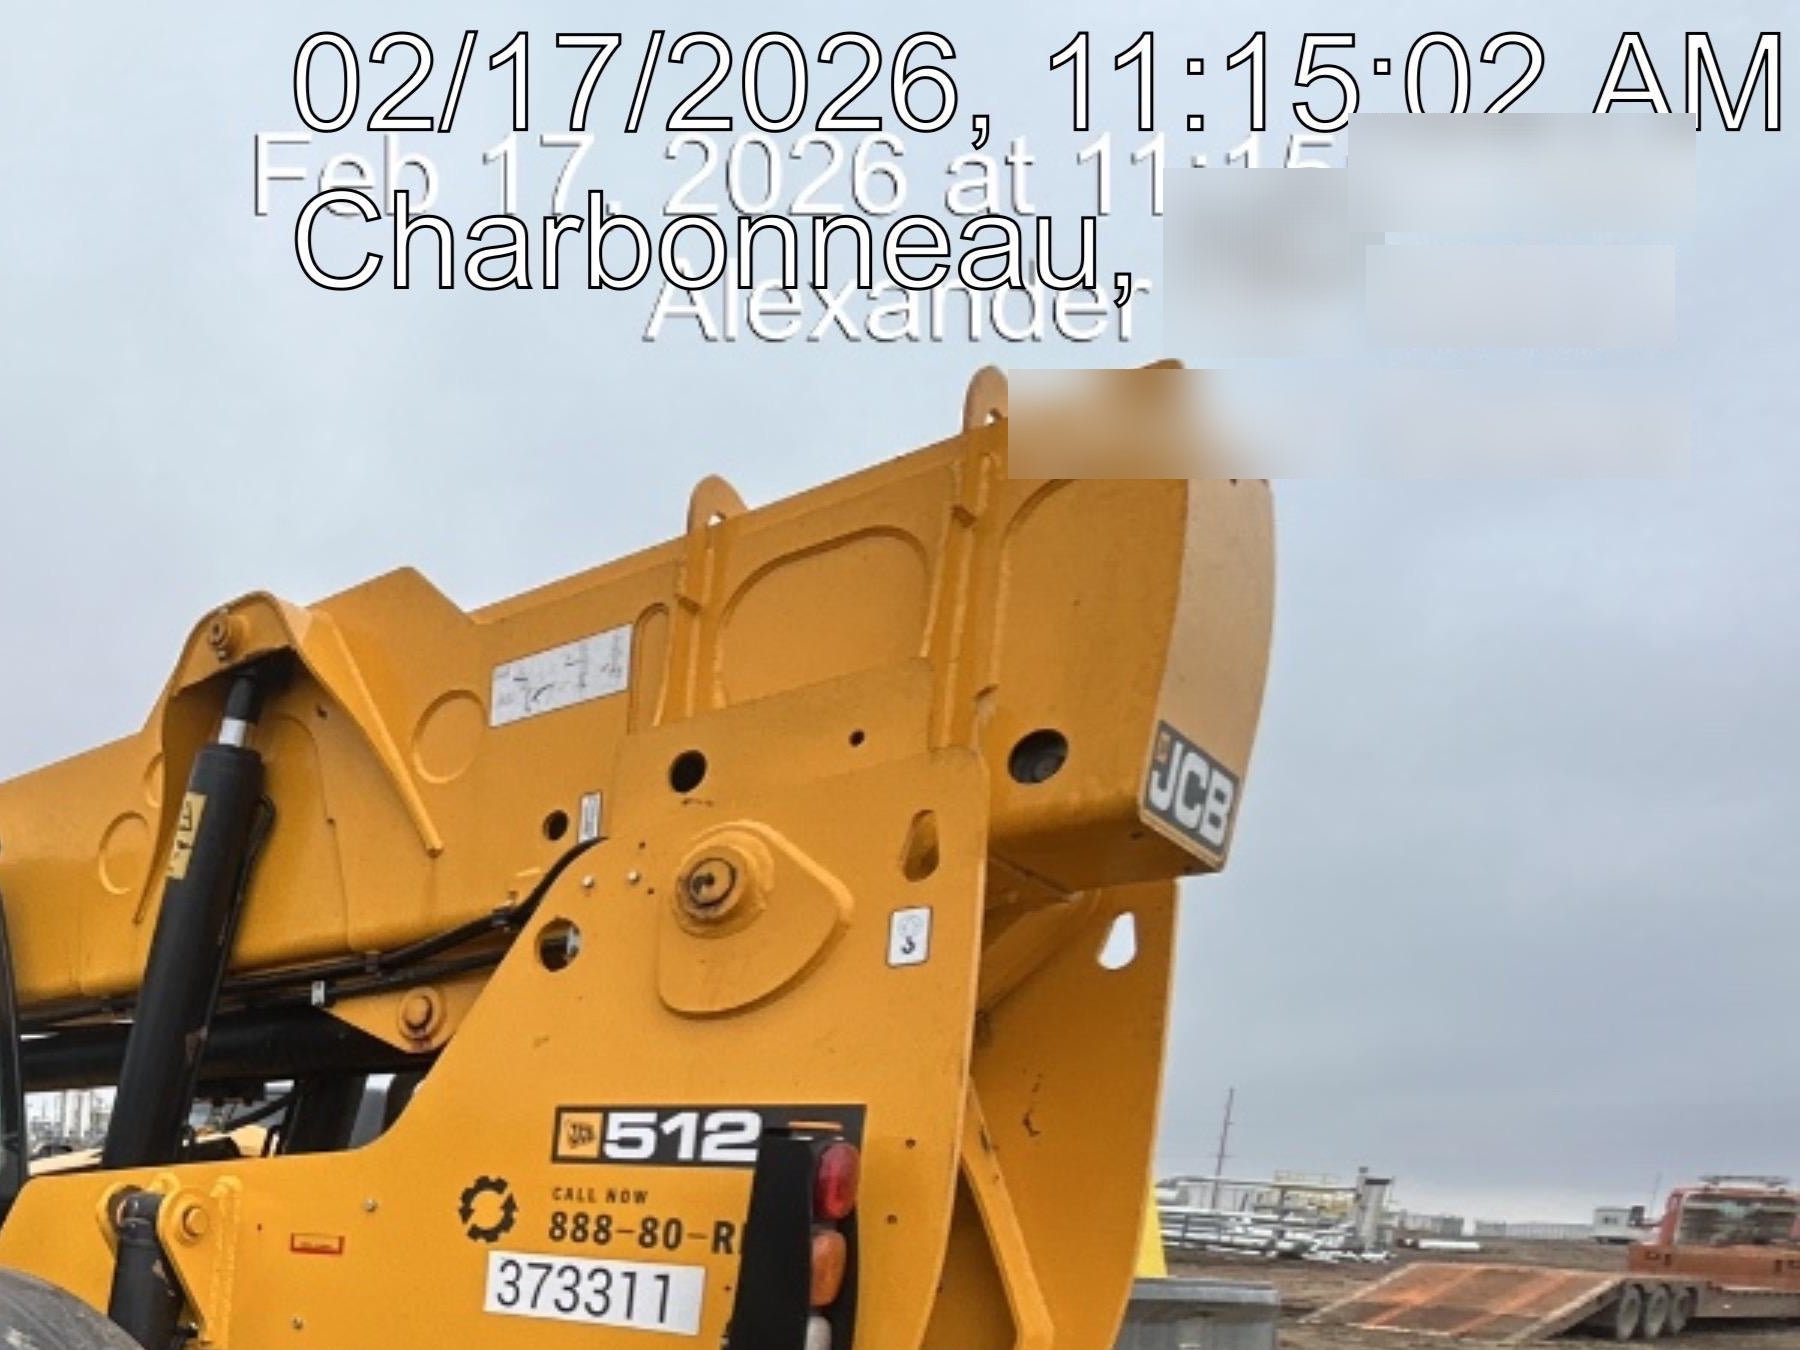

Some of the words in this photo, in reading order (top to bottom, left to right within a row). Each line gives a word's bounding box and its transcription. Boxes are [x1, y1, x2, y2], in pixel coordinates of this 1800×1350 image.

[1150, 739, 1235, 847] JCB
[603, 1109, 763, 1163] 512
[552, 1186, 597, 1204] CALL
[605, 1189, 649, 1205] NOW
[549, 1210, 743, 1255] 888-80-R
[496, 1258, 671, 1323] 373311
